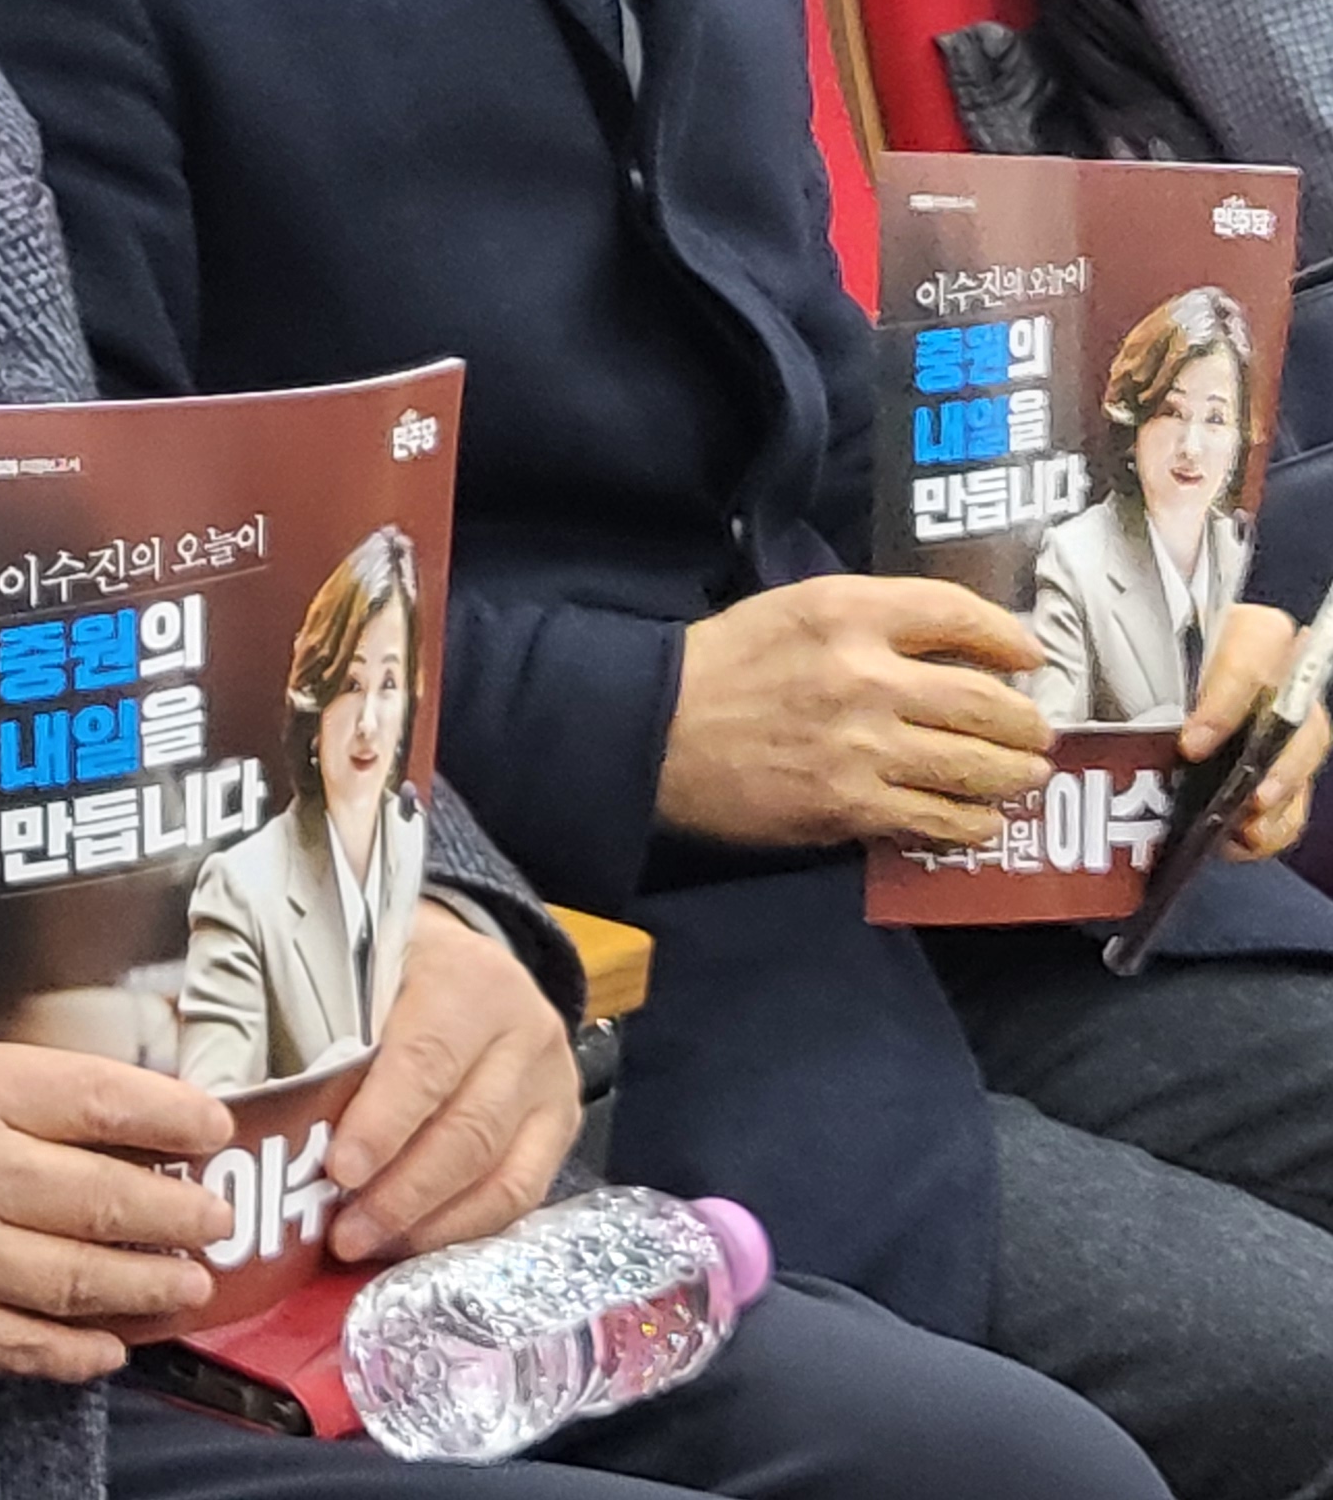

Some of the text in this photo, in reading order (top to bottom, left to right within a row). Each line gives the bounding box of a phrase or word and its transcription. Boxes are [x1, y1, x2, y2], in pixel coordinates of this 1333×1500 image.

[915, 265, 1024, 316] 이수진의
[914, 315, 1051, 394] 중원의
[913, 388, 1051, 466] 내일을
[912, 452, 1092, 543] 만듭니다
[171, 514, 264, 572] 오늘이
[1044, 768, 1172, 874] 이수
